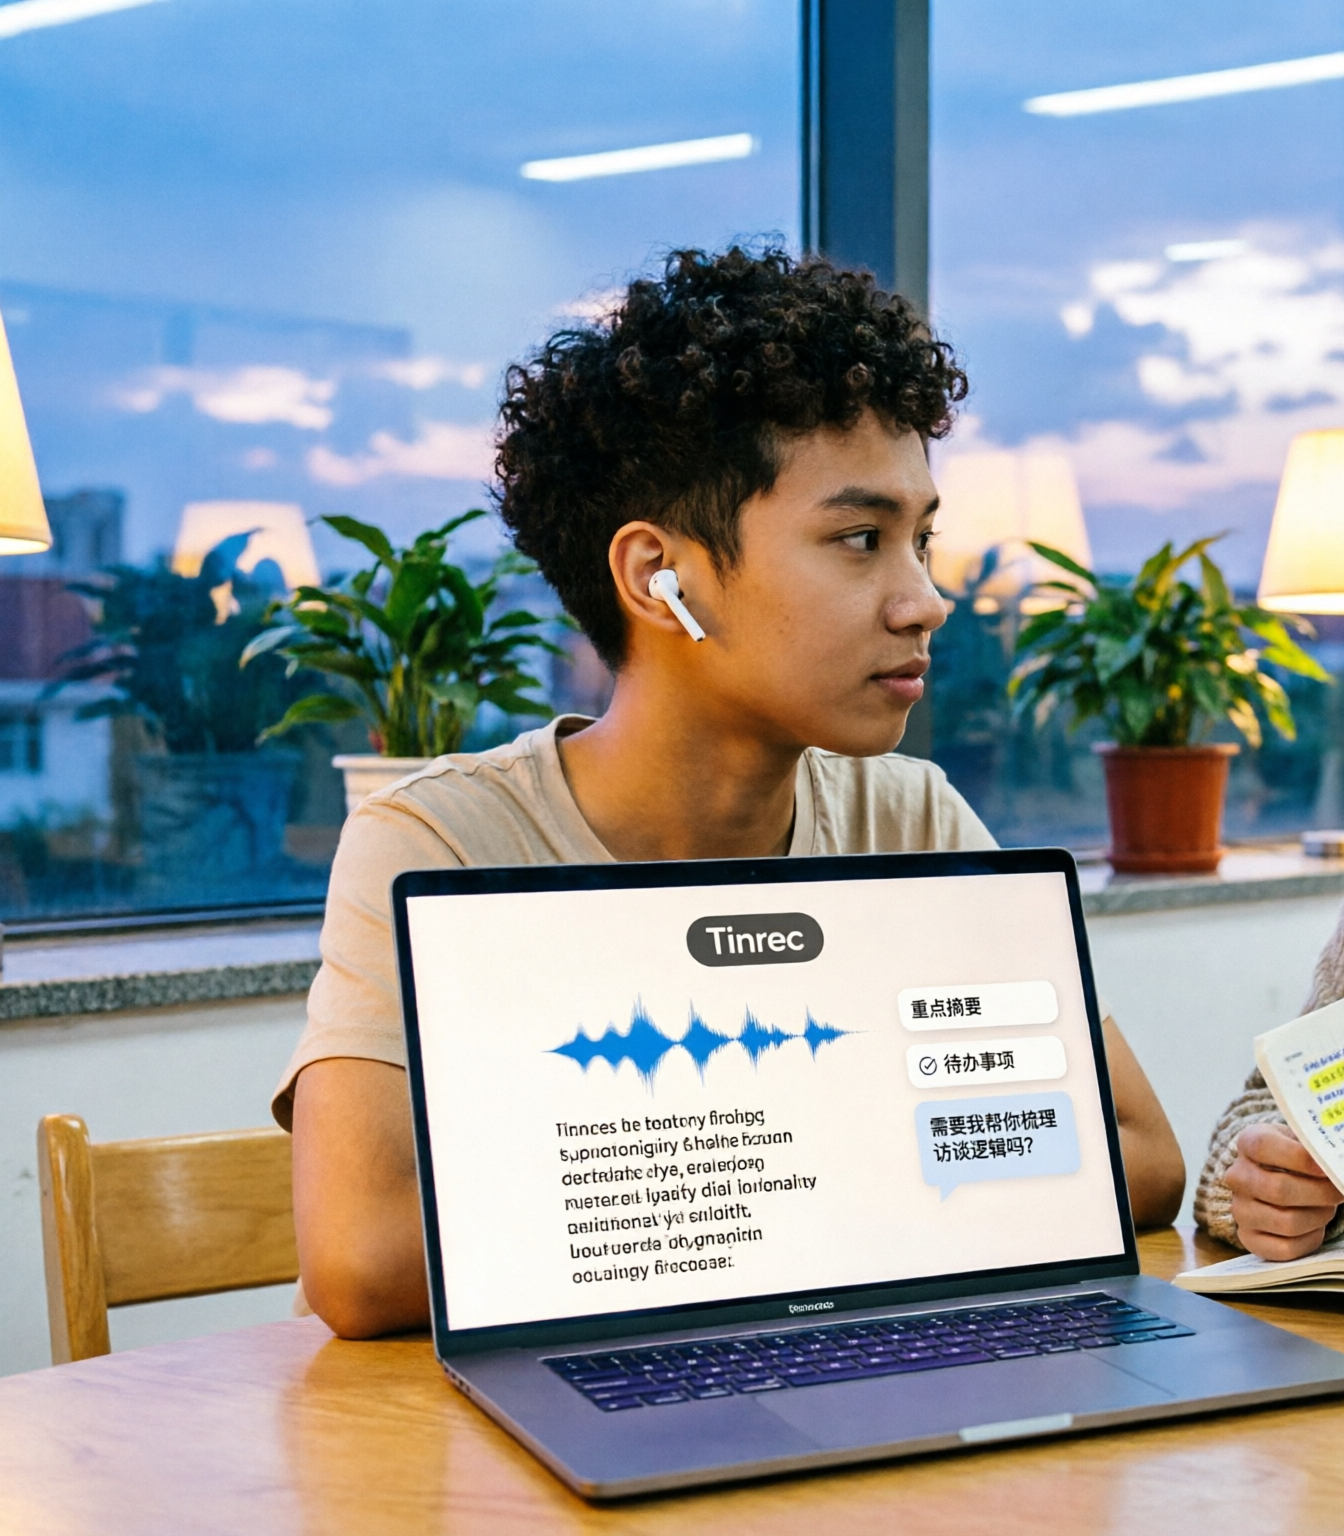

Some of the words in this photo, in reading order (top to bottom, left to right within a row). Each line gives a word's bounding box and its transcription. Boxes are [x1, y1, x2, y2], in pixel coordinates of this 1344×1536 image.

[705, 925, 805, 955] Tinrec
[910, 996, 982, 1019] 重点摘要
[943, 1050, 1015, 1074] 待办事项
[929, 1108, 1058, 1137] 需要我帮你梳理
